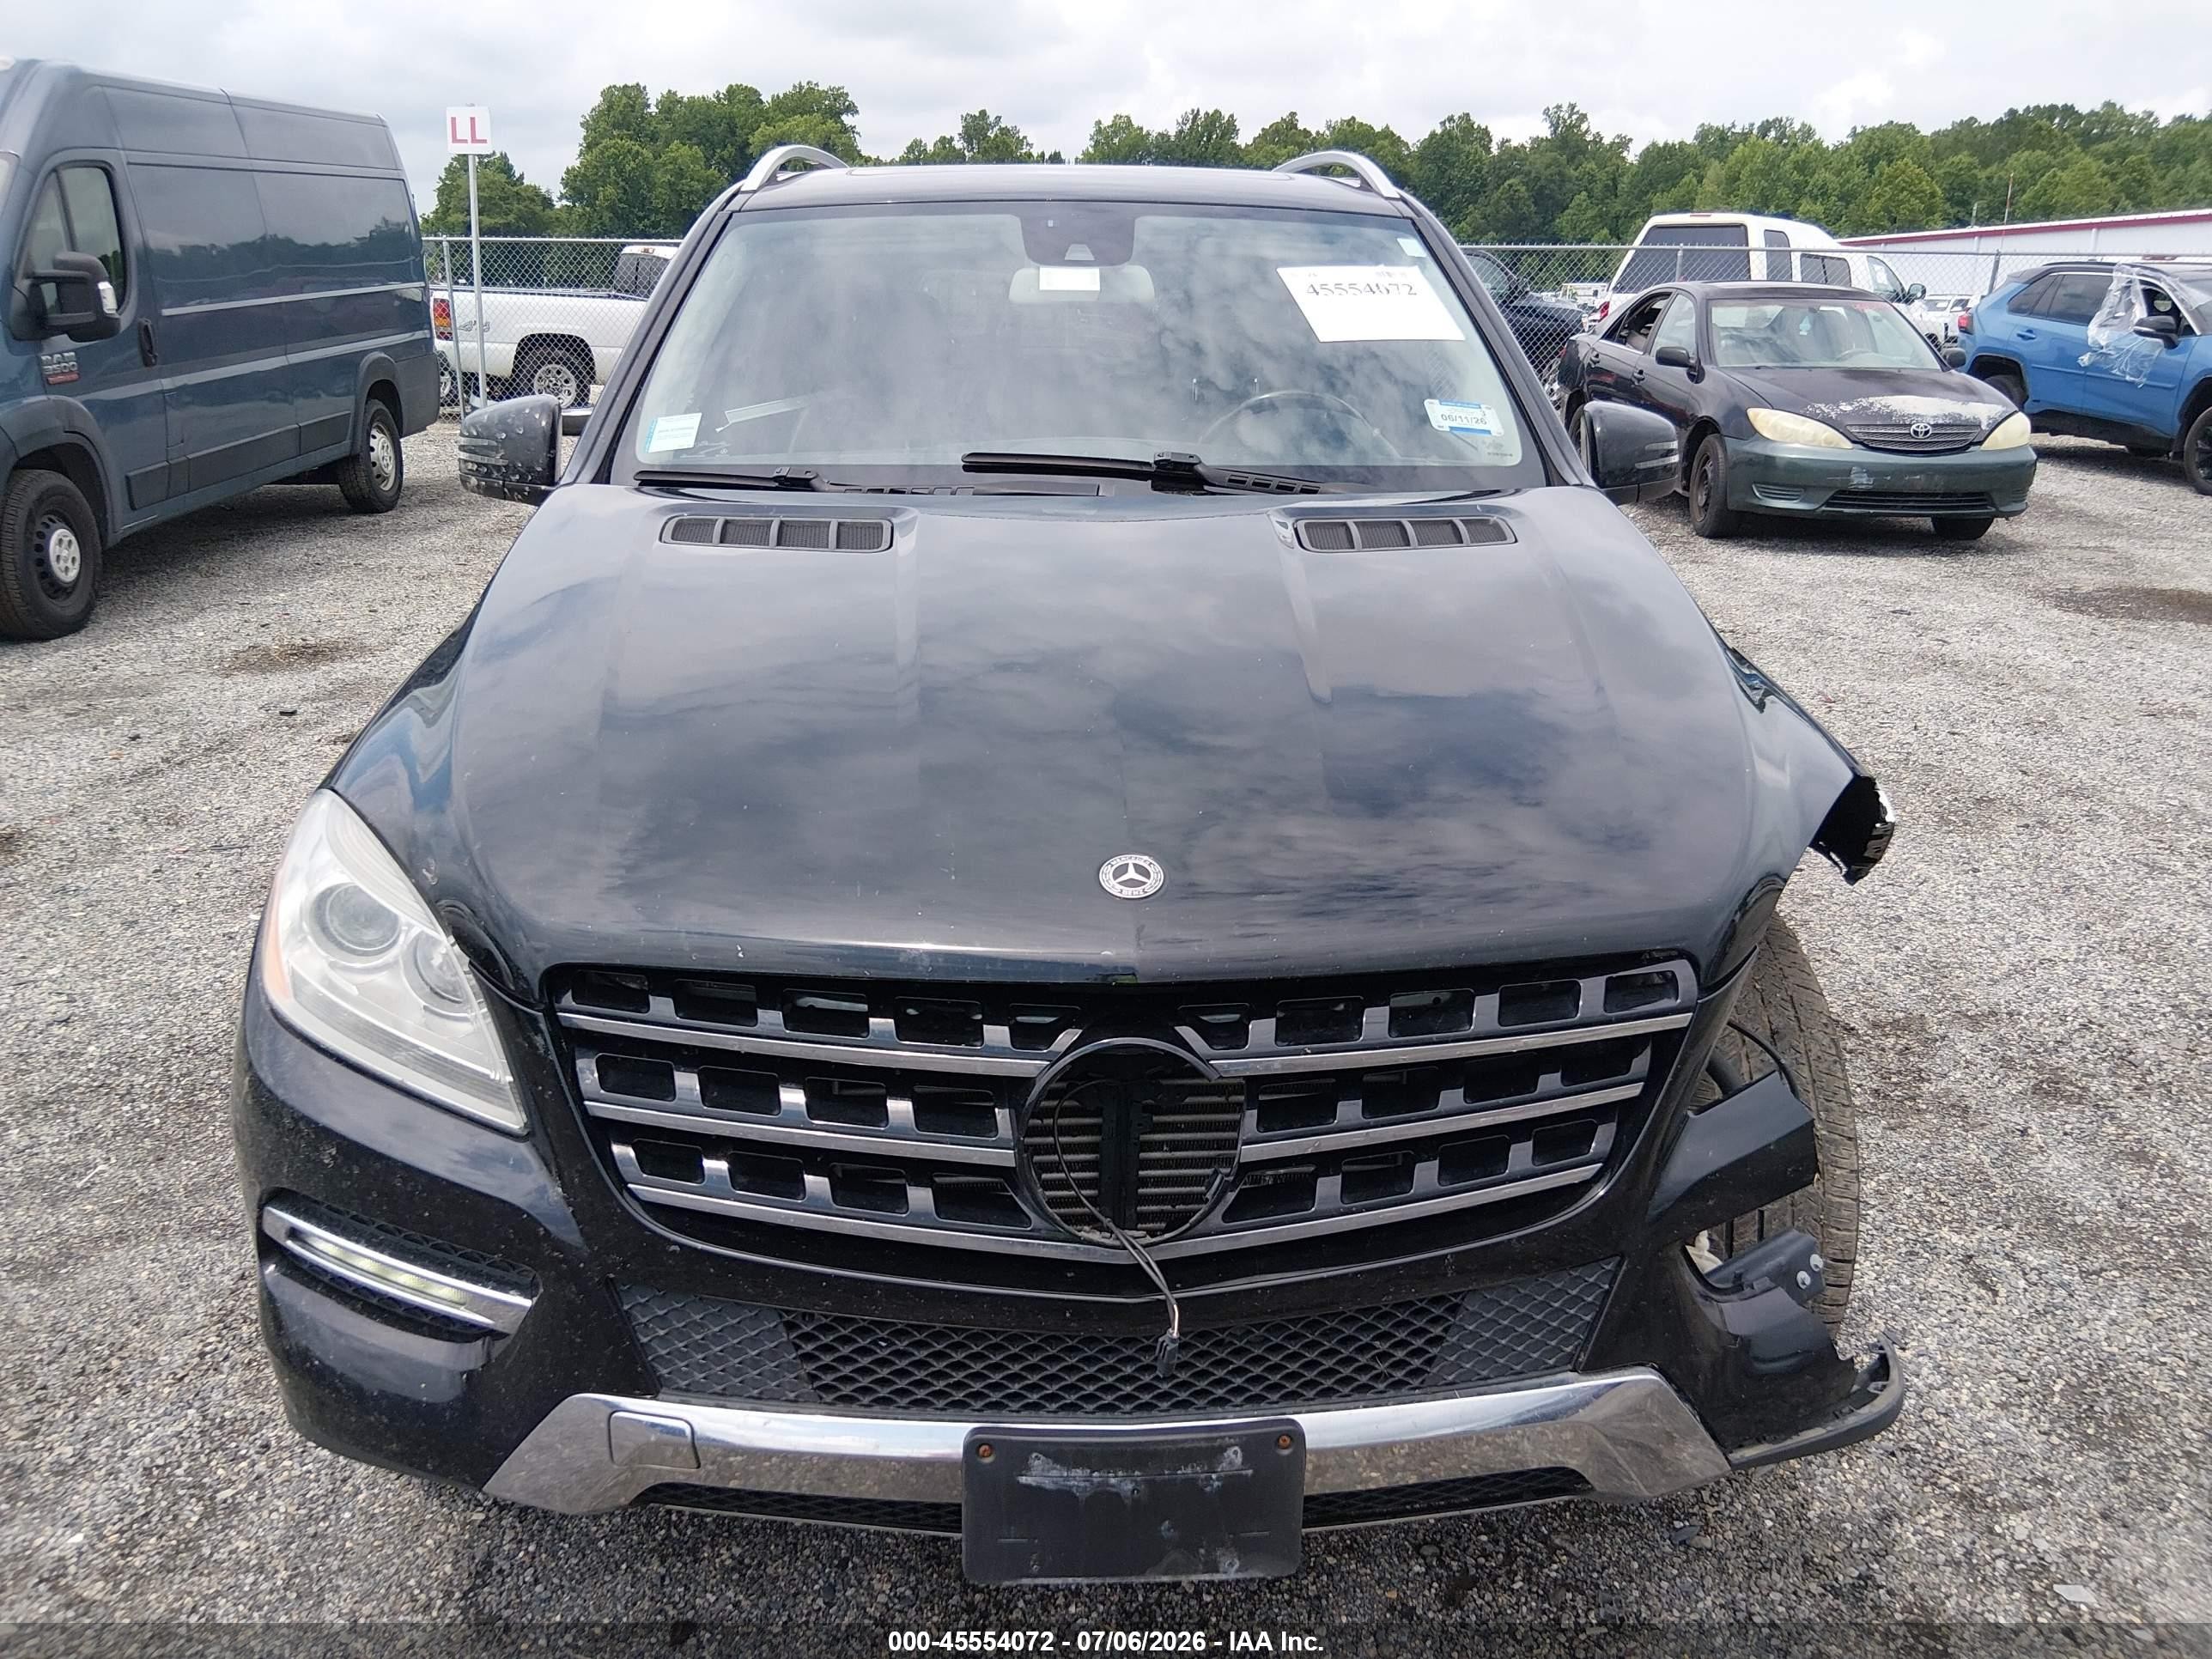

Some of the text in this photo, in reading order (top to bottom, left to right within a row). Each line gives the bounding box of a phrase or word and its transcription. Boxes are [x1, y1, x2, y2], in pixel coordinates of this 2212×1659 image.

[451, 117, 488, 143] LL
[41, 352, 76, 365] RAM
[1441, 414, 1487, 425] 06/11/26
